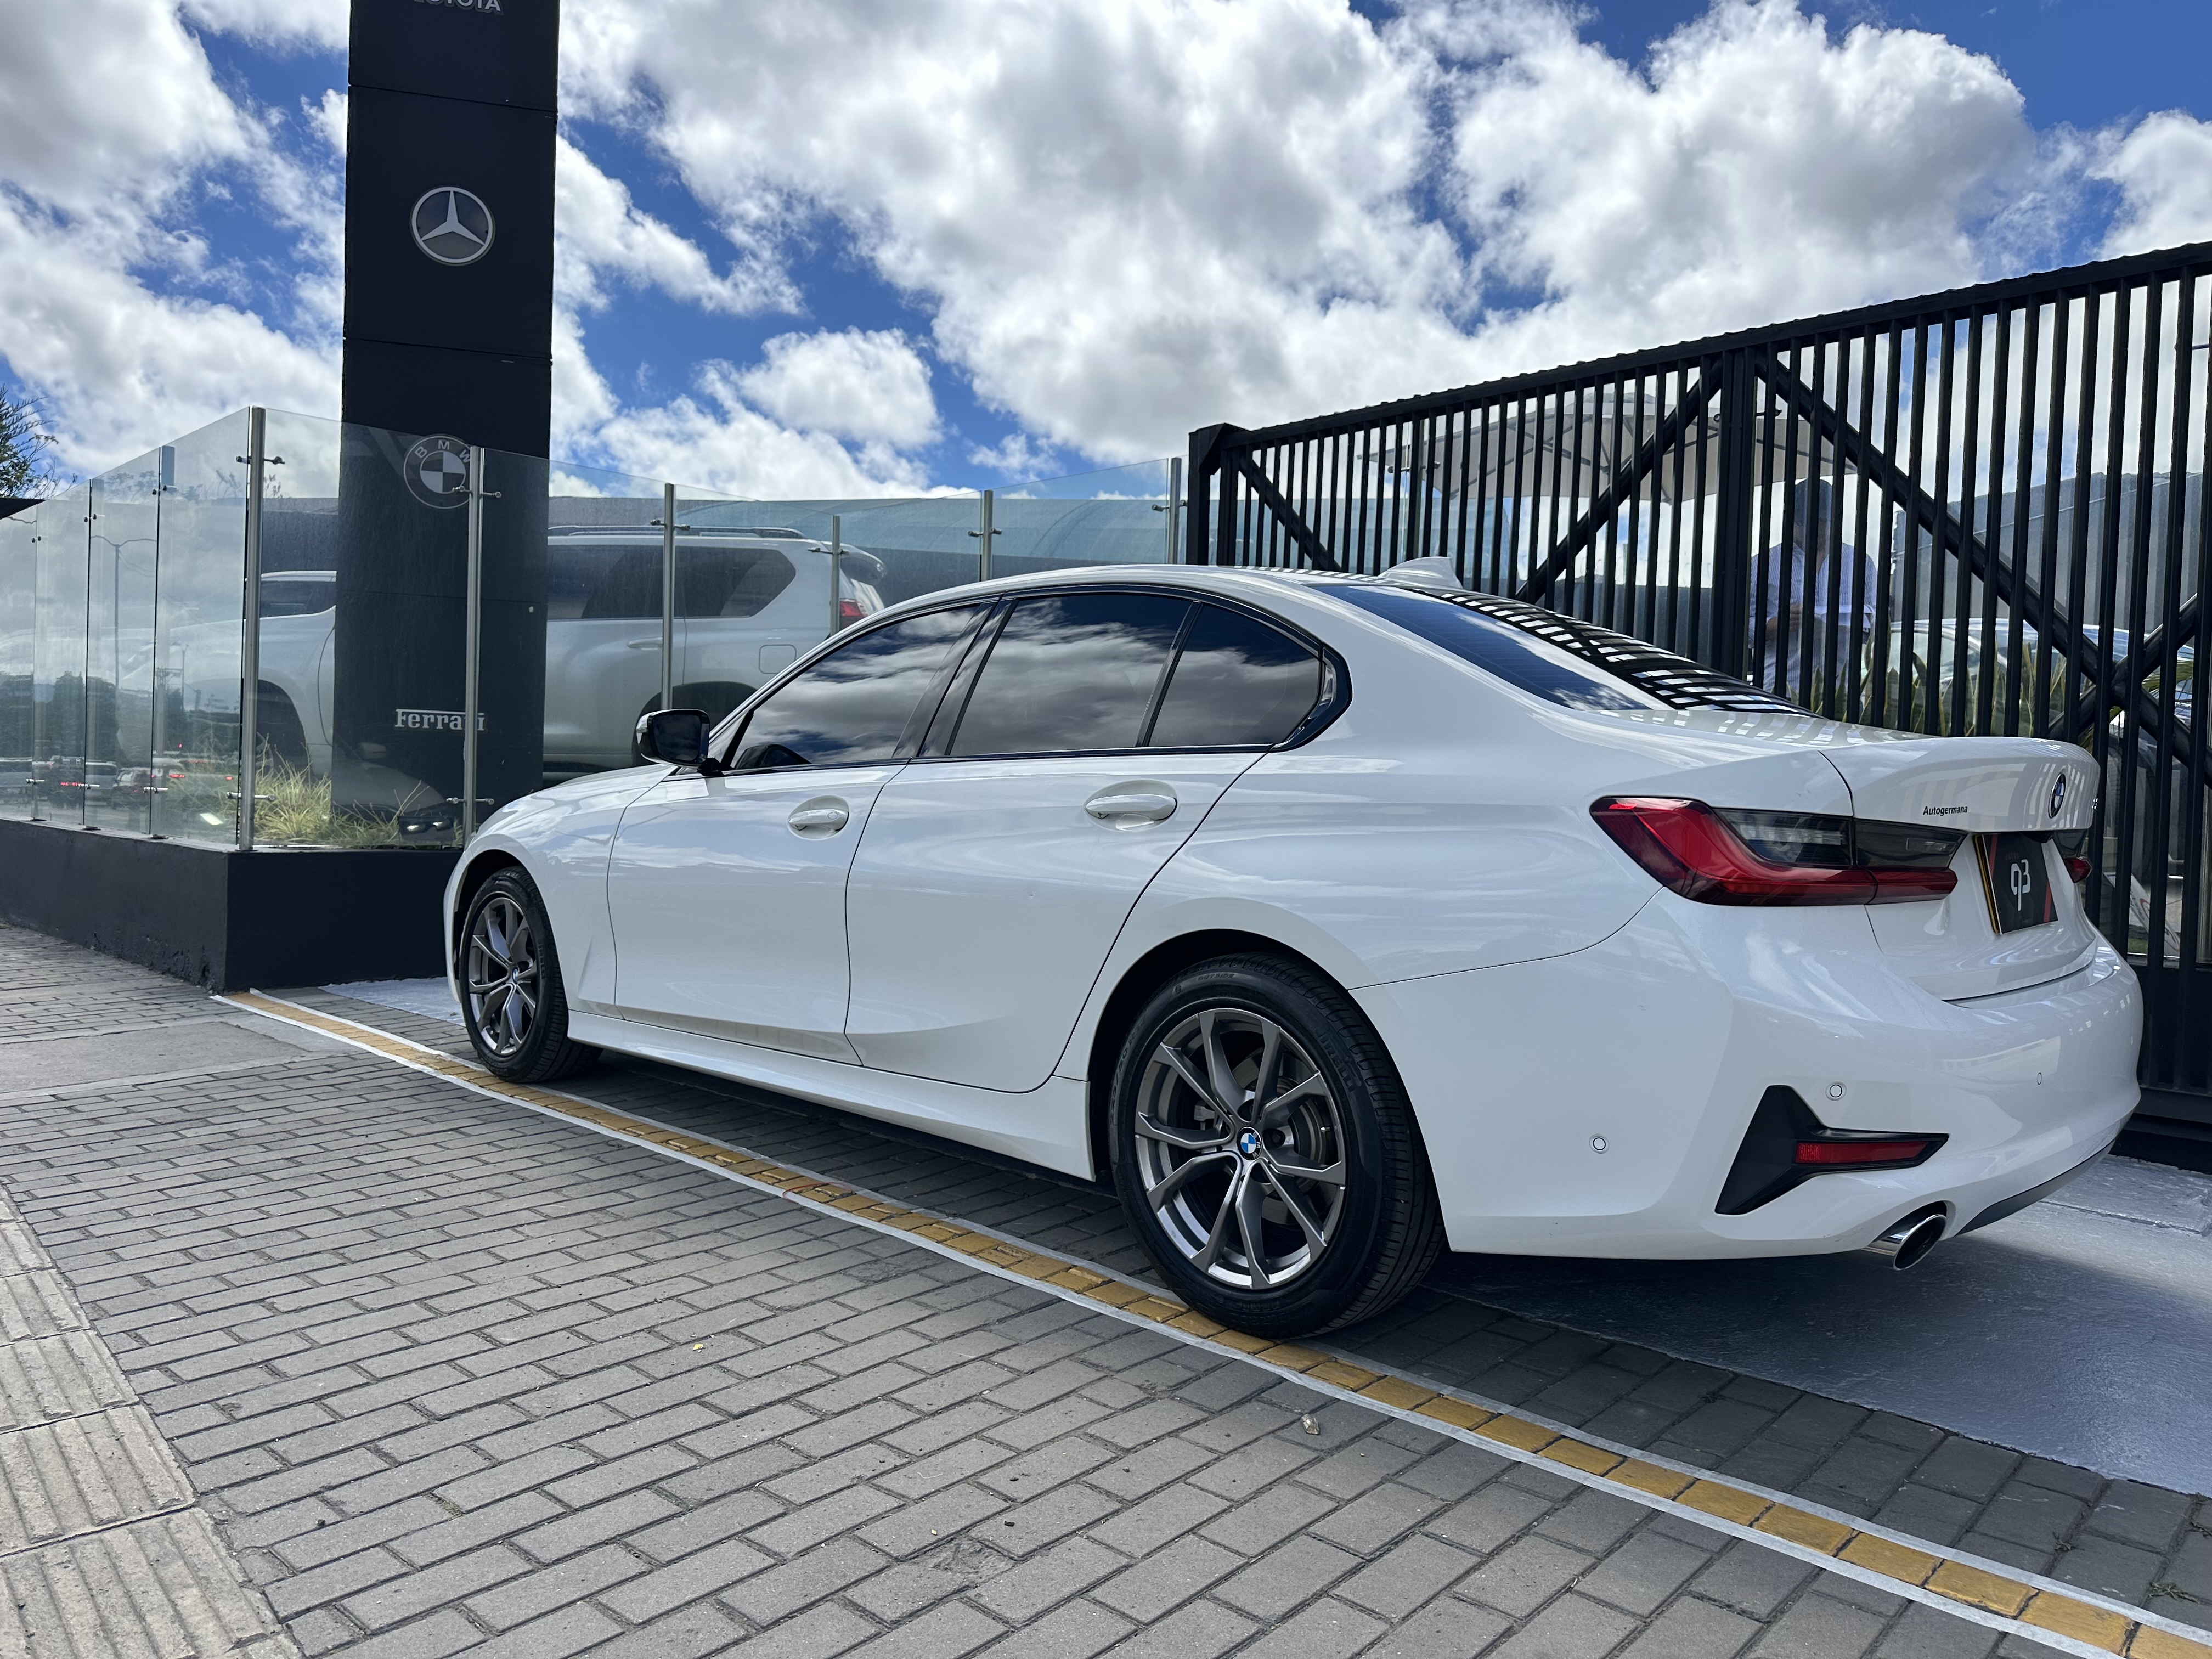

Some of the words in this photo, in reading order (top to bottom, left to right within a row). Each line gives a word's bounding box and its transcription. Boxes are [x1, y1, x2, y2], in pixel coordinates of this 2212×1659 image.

[414, 439, 471, 463] BMW
[394, 708, 485, 731] Ferrai
[1922, 805, 1968, 817] Autogermana
